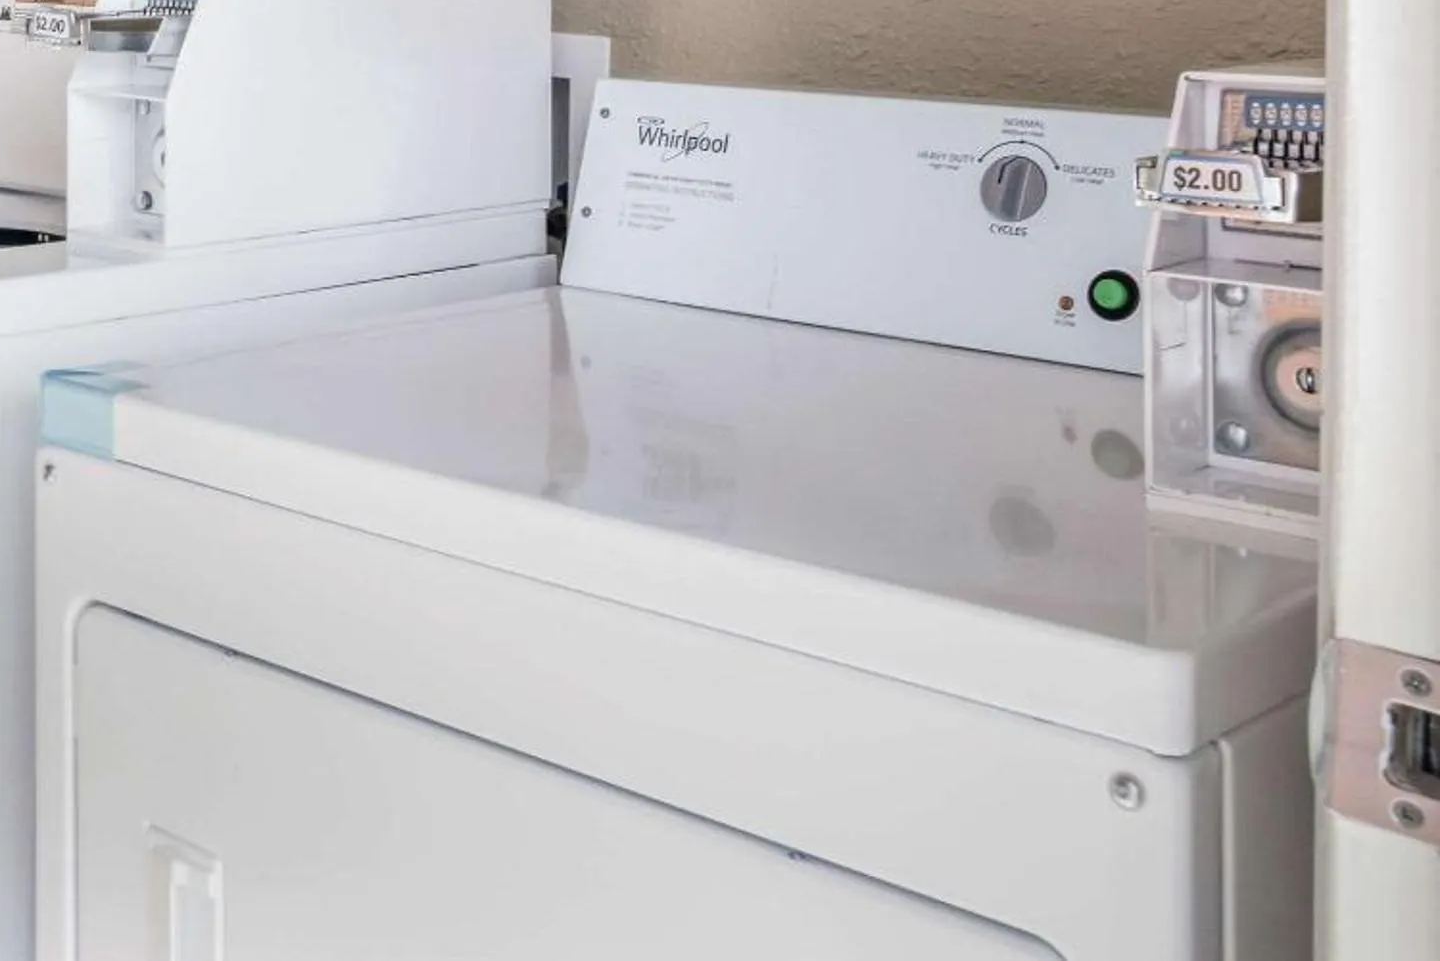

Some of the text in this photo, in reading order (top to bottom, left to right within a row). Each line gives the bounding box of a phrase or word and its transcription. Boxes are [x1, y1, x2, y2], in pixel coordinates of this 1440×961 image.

[34, 15, 66, 34] $2.00
[638, 125, 730, 156] Whirlpool
[1173, 166, 1243, 192] $2.00
[988, 222, 1028, 237] CYCLES
